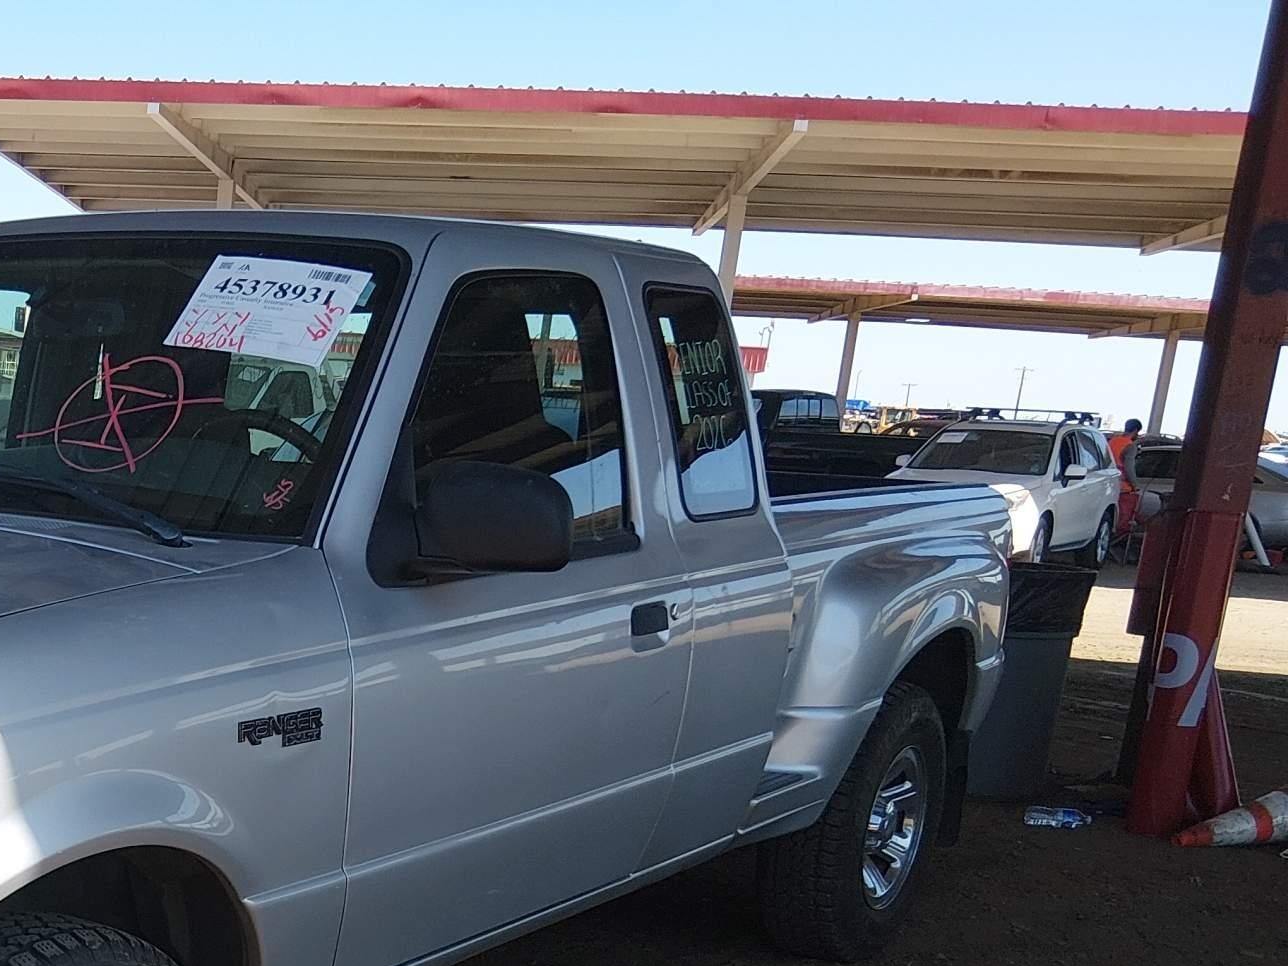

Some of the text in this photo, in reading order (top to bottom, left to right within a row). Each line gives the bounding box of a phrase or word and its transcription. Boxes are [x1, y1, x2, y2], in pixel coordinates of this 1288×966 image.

[214, 276, 337, 306] 45378931
[675, 338, 727, 377] ENIOR
[685, 380, 717, 409] LASS
[237, 706, 324, 746] RANGER
